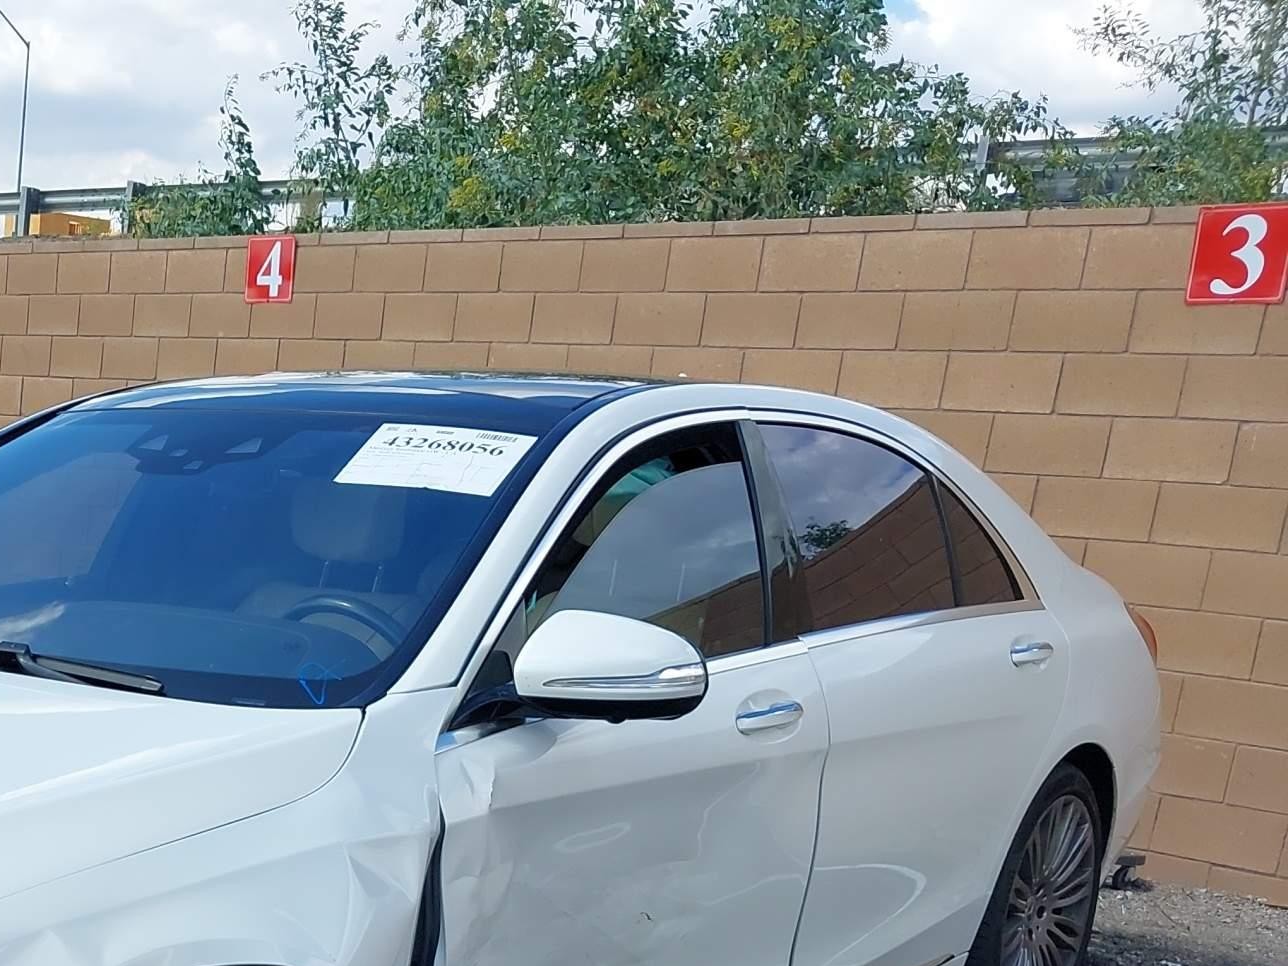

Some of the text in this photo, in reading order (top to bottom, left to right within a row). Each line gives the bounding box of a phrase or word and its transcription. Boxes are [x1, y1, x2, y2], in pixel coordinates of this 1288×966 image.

[256, 240, 283, 297] 4
[1209, 213, 1268, 295] 3
[383, 435, 508, 457] 43268056
